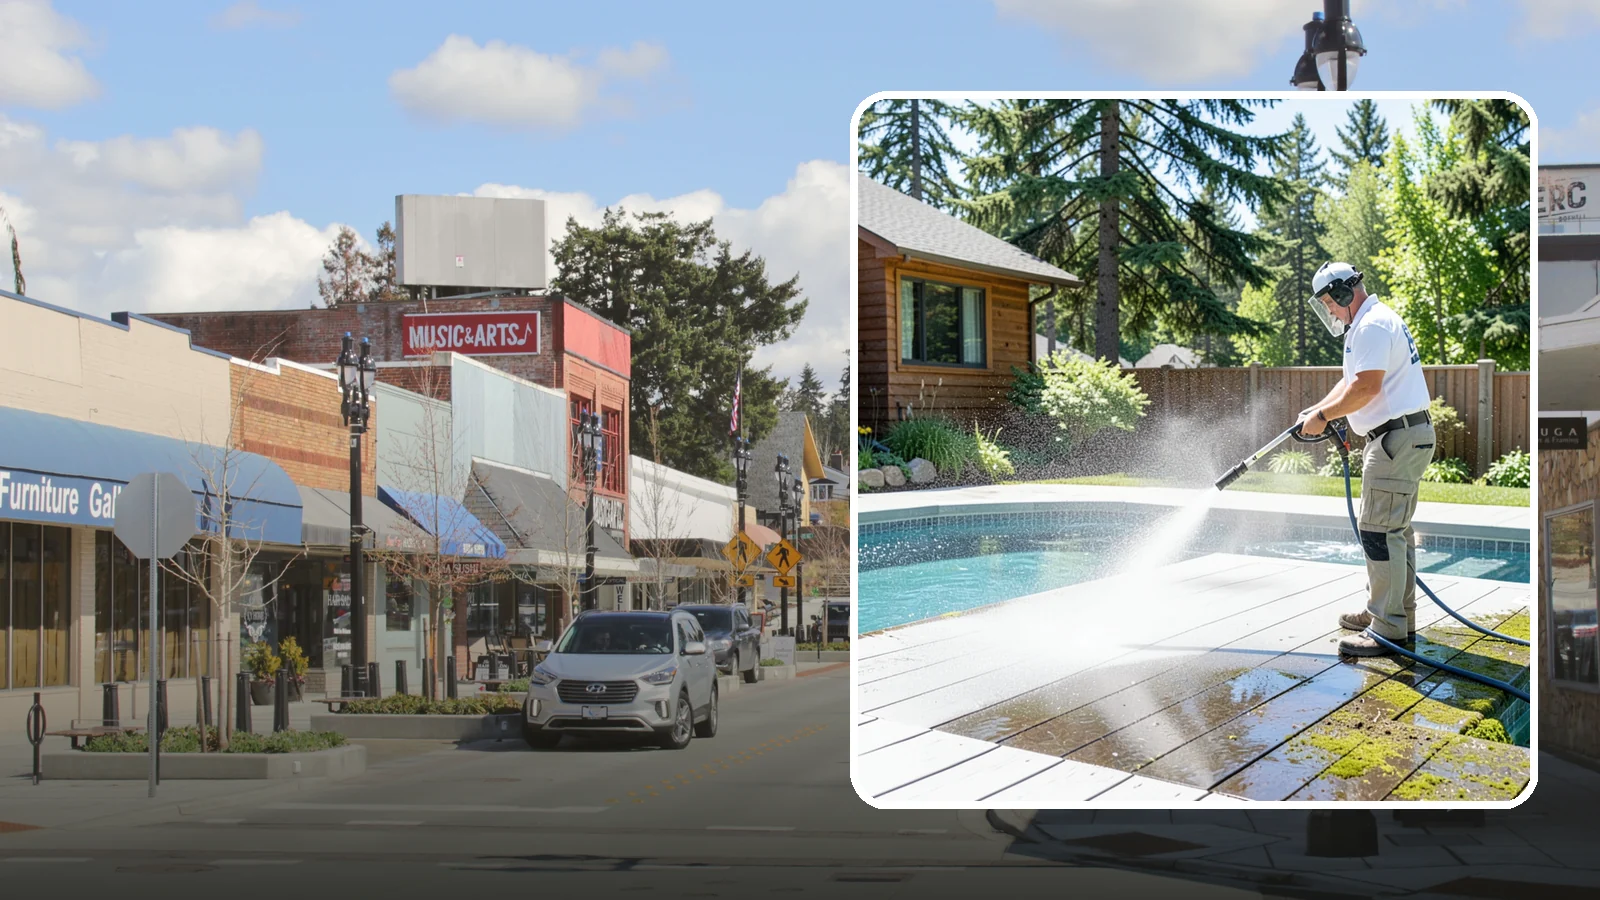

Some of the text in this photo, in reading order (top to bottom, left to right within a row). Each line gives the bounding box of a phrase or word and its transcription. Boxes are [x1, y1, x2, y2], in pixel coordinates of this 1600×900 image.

[409, 323, 520, 349] MUSIC&ARTS
[0, 471, 121, 519] Furniture Gal
[452, 563, 480, 574] SUSHI
